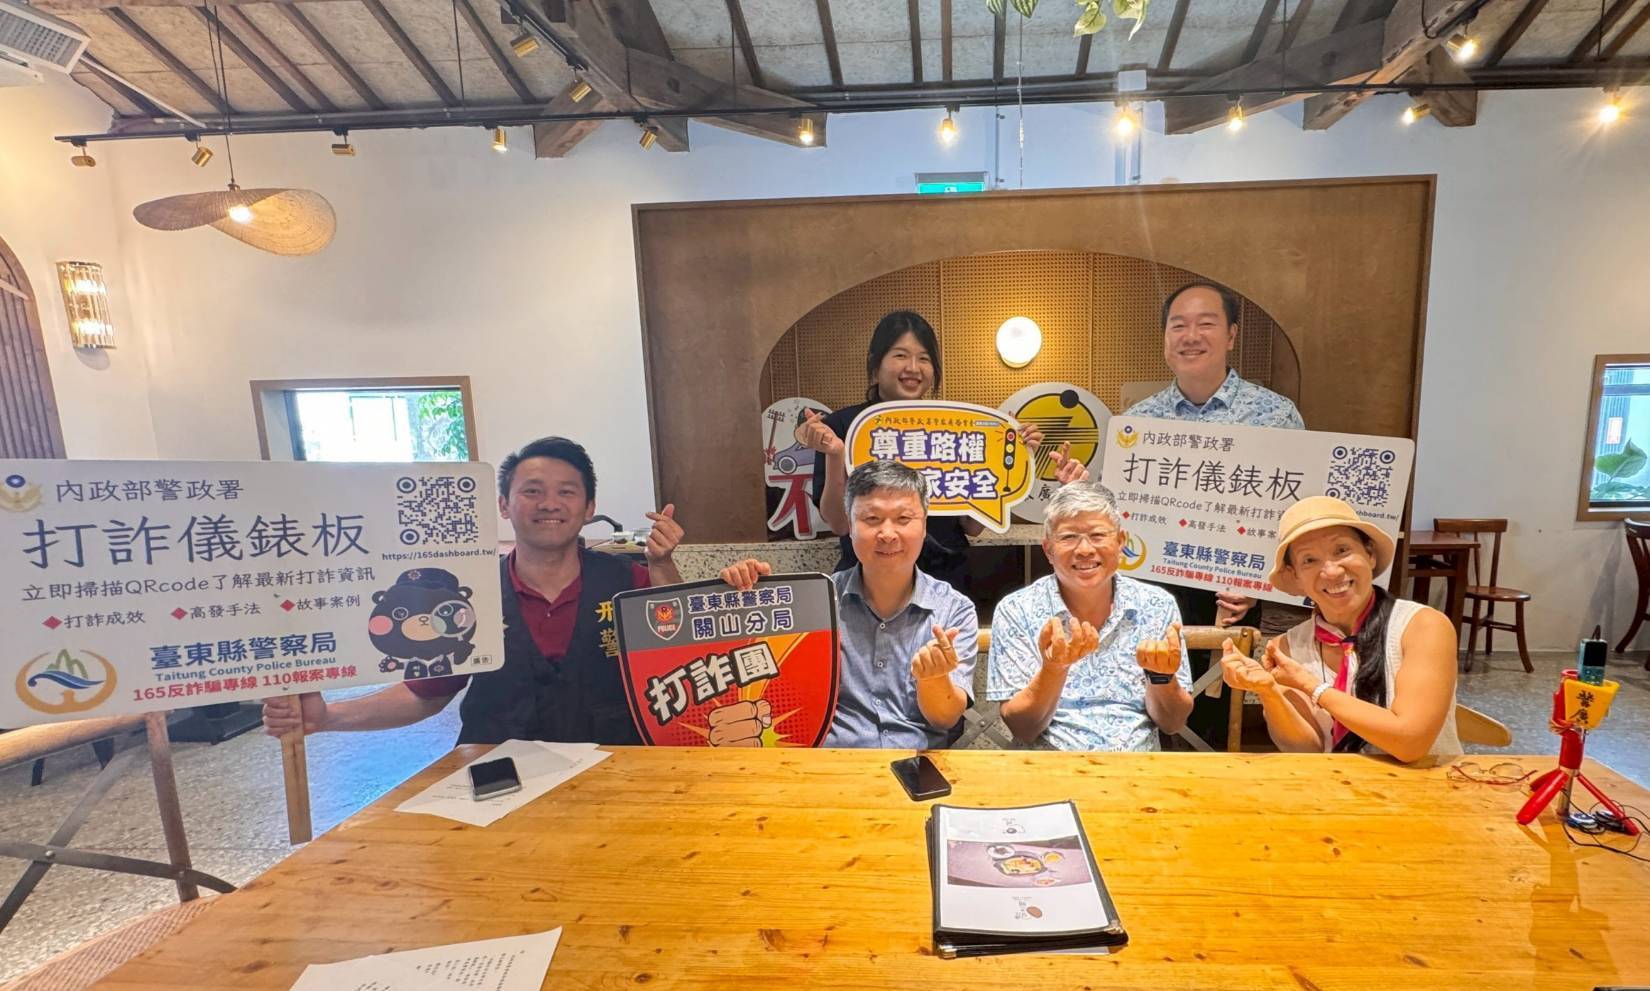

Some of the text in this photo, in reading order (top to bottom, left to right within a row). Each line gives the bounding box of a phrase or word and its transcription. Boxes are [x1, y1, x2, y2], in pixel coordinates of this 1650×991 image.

[871, 428, 985, 463] 尊重路權
[1142, 431, 1235, 452] 內政部警政署
[55, 479, 244, 503] 內政部警政署
[921, 467, 998, 499] 家安全
[1123, 452, 1304, 501] 打詐儀錶板
[22, 512, 369, 569] 打詐儀錶板
[1130, 511, 1277, 540] 打詐成效 高發手法 故事案
[382, 548, 497, 561] https://165dashboard.tw/
[1162, 540, 1266, 571] 臺東縣警察局
[1163, 558, 1262, 579] Taitung County Police Bureau
[22, 566, 376, 602] 立即掃描QRcode了解最新打詐資訊
[1150, 564, 1273, 593] 165反詐騙專線 110報案專線
[64, 594, 361, 629] 打詐成效 高發手法 故事案例
[688, 586, 793, 614] 臺東縣警察局
[692, 608, 794, 640] 關山分局
[149, 631, 337, 670] 臺東縣警察局
[133, 664, 358, 701] 165反詐騙專線 110報案專線
[155, 656, 336, 682] Taitung County Police Bureau
[647, 642, 779, 723] 打詐團
